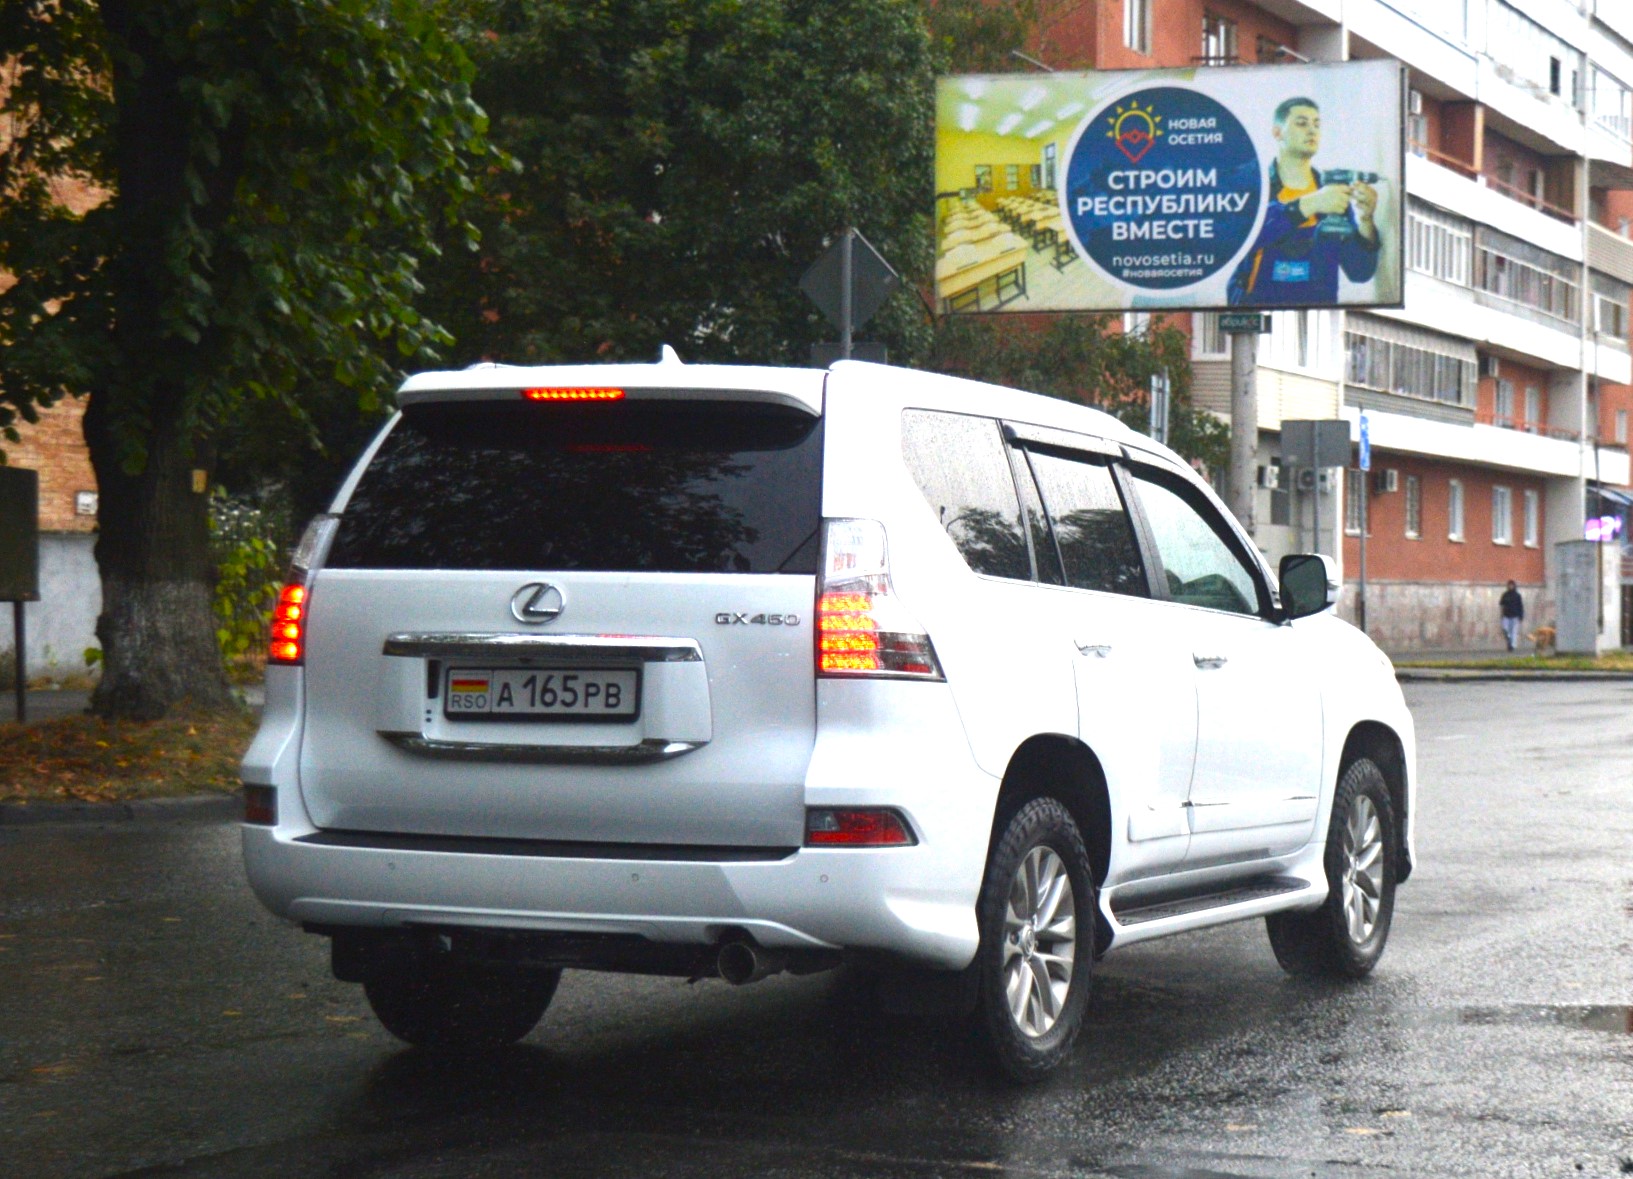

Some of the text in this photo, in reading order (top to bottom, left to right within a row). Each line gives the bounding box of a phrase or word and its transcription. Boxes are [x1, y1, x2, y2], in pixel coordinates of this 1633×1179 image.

[1168, 117, 1217, 130] НОВАЯ
[1168, 133, 1223, 146] ОСЕТИЯ
[1107, 168, 1217, 190] СТРОИМ
[1077, 192, 1249, 216] РЕСПУБЛИКУ
[1112, 219, 1214, 240] ВМЕСТЕ
[1112, 252, 1215, 267] novosetia.ru
[715, 612, 801, 626] GX460
[451, 694, 487, 709] RSO
